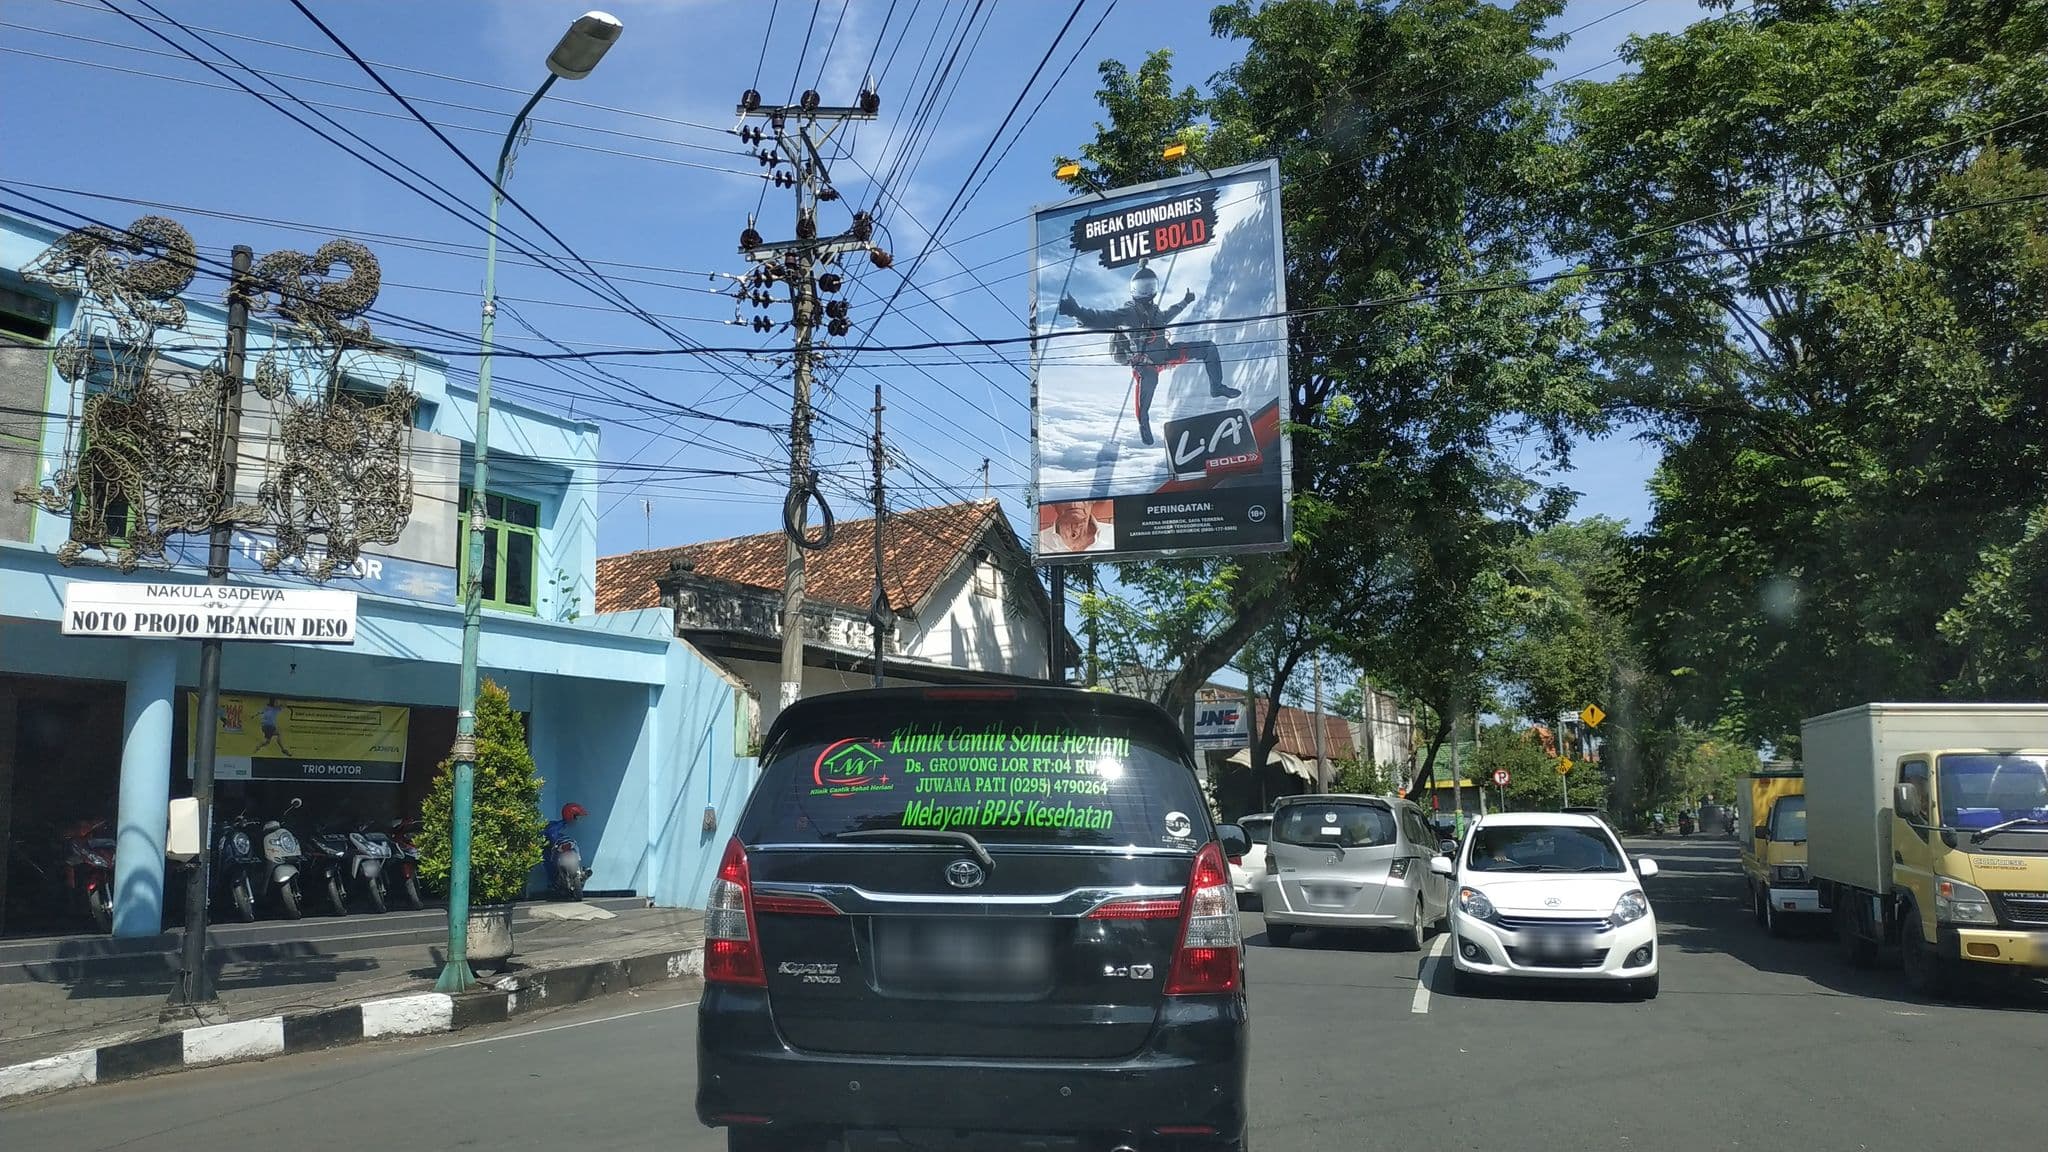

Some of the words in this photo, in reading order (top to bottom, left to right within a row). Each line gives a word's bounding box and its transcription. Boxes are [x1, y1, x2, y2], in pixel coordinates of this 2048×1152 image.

[1085, 216, 1124, 239] BREAK
[1127, 197, 1202, 229] BOUNDARIES
[1109, 231, 1151, 262] LIVE
[1155, 218, 1206, 252] BOLD
[1209, 455, 1247, 467] BOLD
[1147, 503, 1214, 514] PERINGATAN:
[146, 585, 213, 598] NAKULA
[218, 588, 285, 602] SADEWA
[72, 611, 127, 632] NOTO
[133, 613, 199, 635] PROJO
[206, 615, 296, 636] MBANGUN
[302, 618, 348, 637] DESO
[1196, 709, 1239, 726] JNE
[889, 722, 945, 753] Klinik
[948, 722, 1007, 753] Cantik
[1009, 723, 1061, 753] Sehat
[302, 764, 326, 774] TRIO
[328, 765, 362, 775] MOTOR
[905, 758, 924, 773] Ds.
[930, 757, 998, 773] GROWONG
[999, 757, 1029, 772] LOR
[1032, 757, 1071, 773] RT:04
[916, 778, 971, 793] JUWANA
[975, 778, 1007, 793] PATI
[1010, 778, 1051, 797] (0295)
[1054, 780, 1108, 795] 4790264
[902, 799, 981, 831] Melayani
[981, 800, 1024, 828] BPJS
[1024, 800, 1113, 829] Kesehatan
